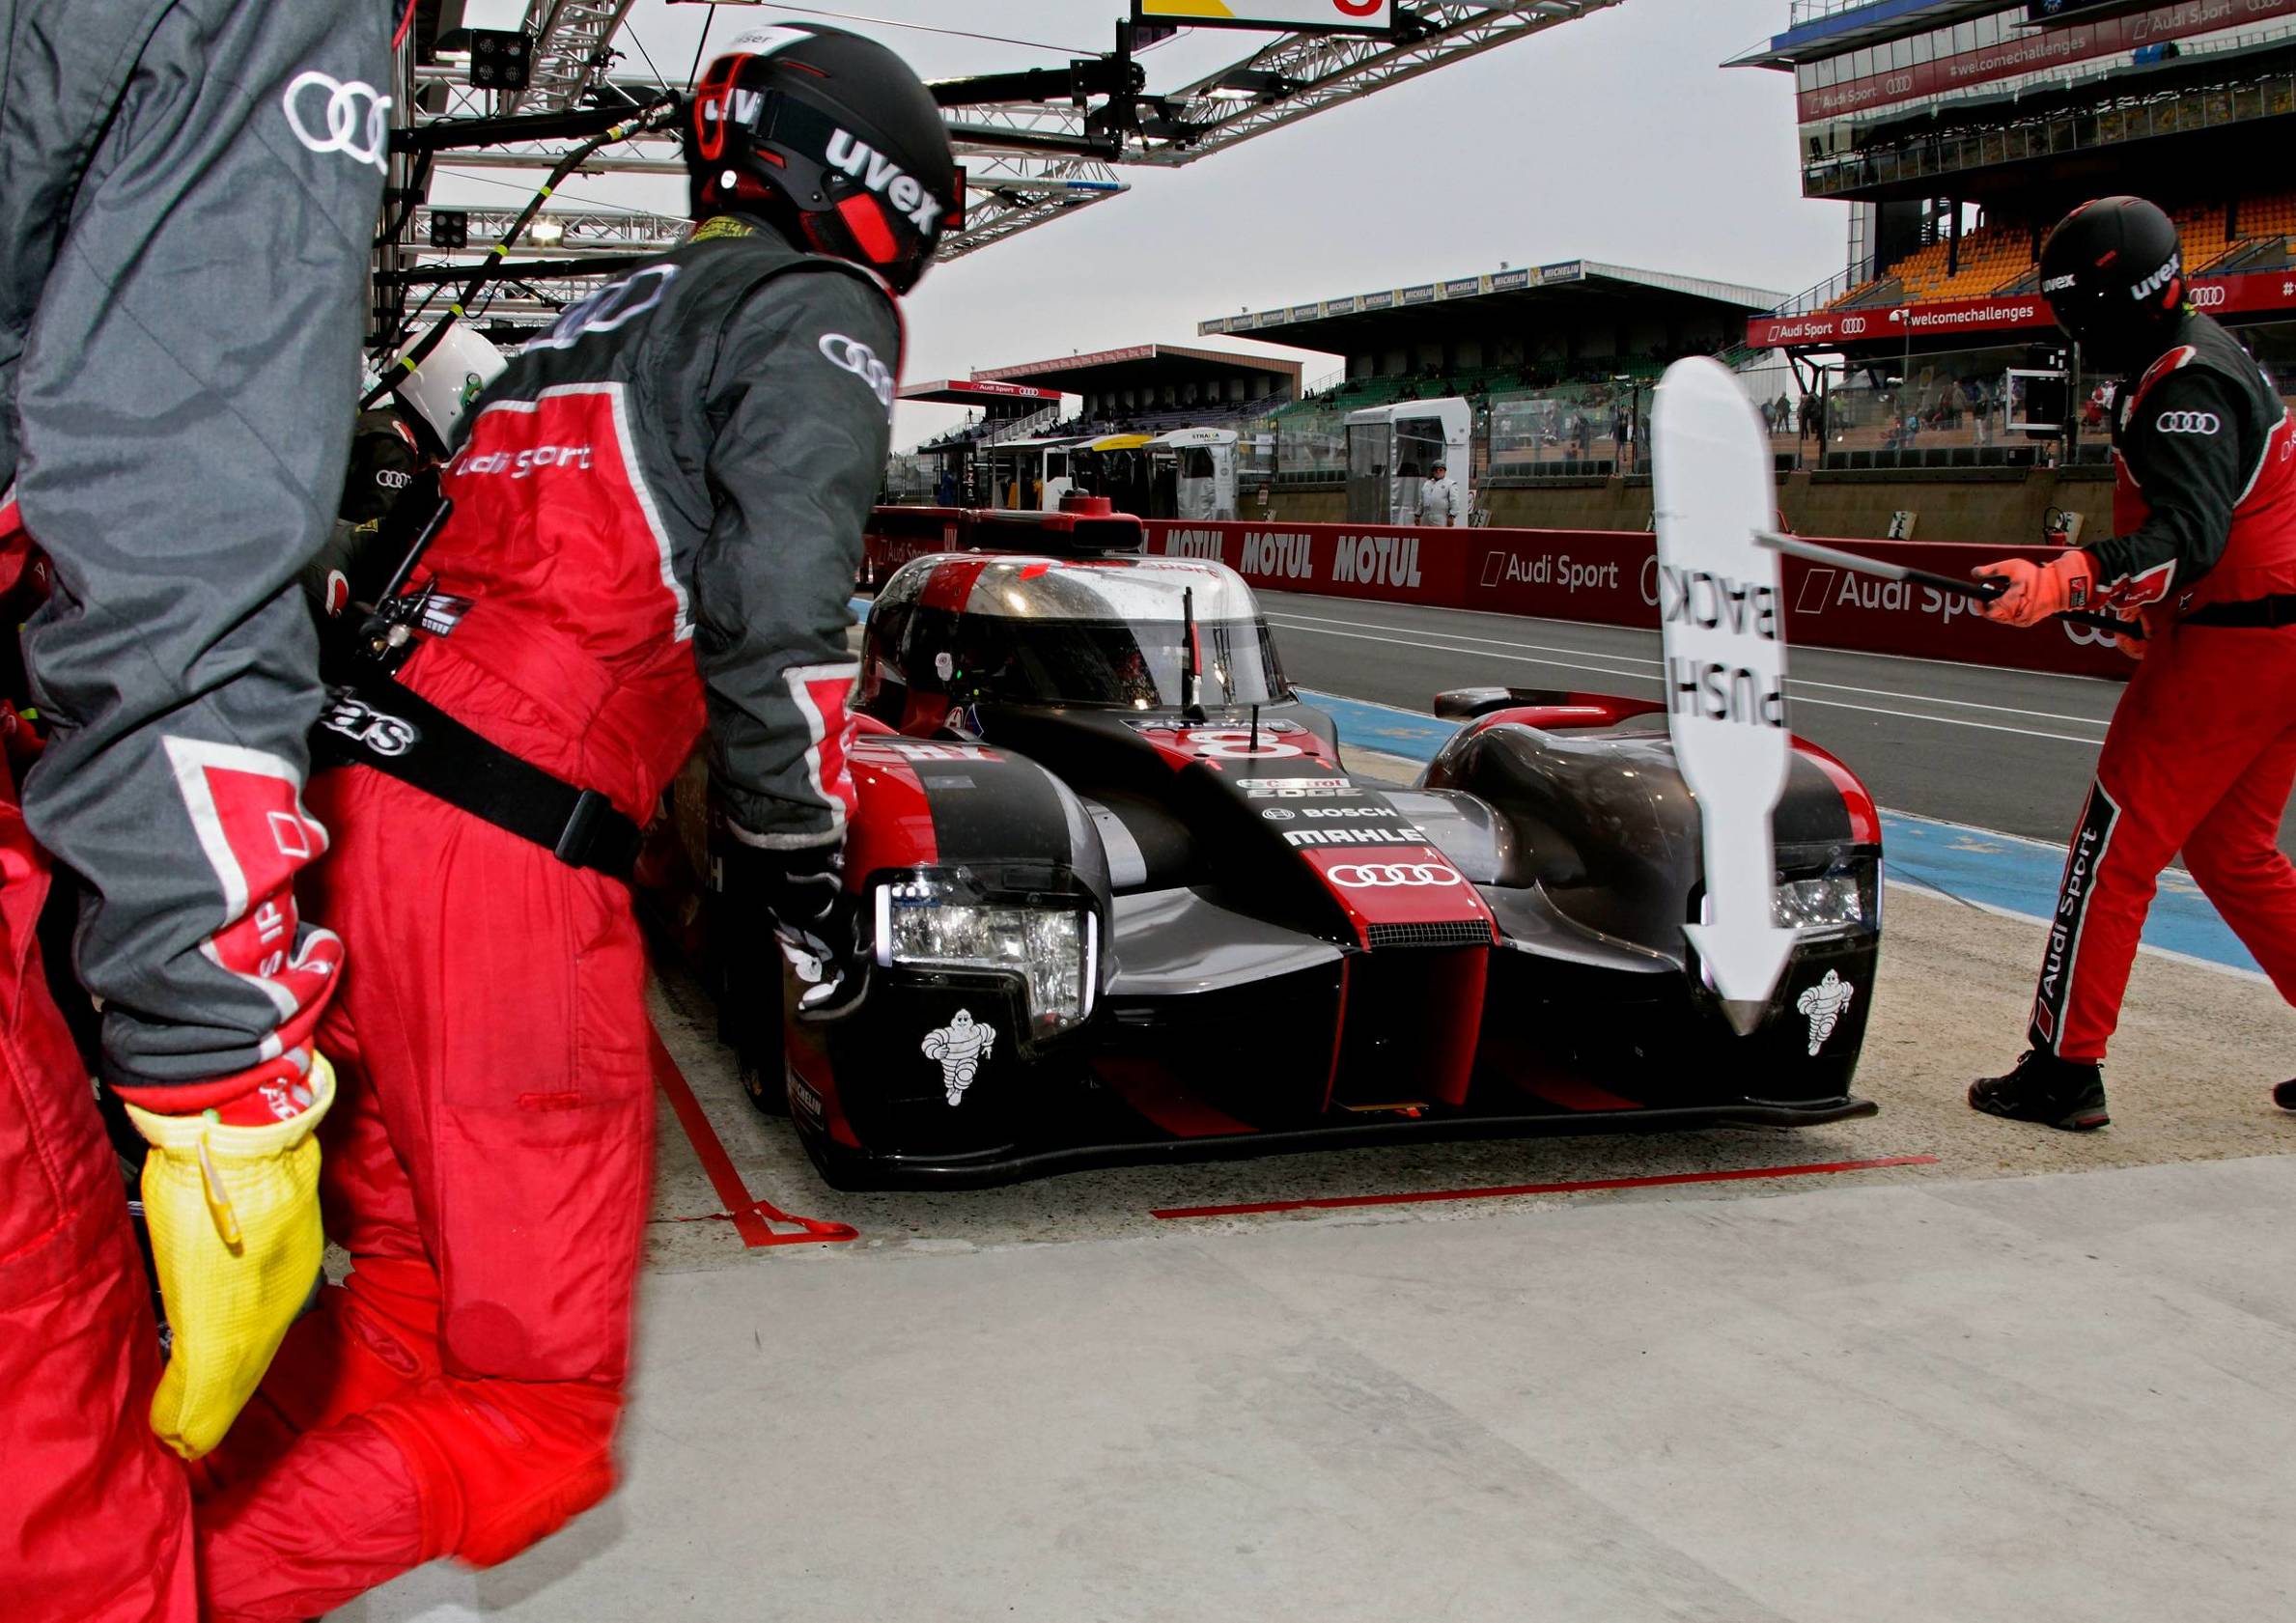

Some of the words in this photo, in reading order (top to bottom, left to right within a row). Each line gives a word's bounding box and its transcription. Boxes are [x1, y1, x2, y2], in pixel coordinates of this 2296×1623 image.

[2152, 11, 2188, 32] Audi
[2190, 3, 2232, 24] Sport
[1949, 37, 2086, 76] #welcomechallenges
[1823, 93, 1847, 109] Audi
[1847, 86, 1878, 104] Sport
[826, 127, 943, 235] uvex
[1494, 271, 1526, 285] MICHELIN
[1544, 264, 1581, 278] MICHELIN
[2041, 273, 2076, 294] uvex
[2131, 253, 2180, 300] uvex
[1779, 323, 1803, 338] Audi
[1805, 322, 1833, 338] Sport
[1905, 306, 2033, 326] welcomechallenges
[1165, 529, 1224, 564] MOTUL
[1241, 532, 1312, 578] MOTUL
[1332, 535, 1421, 588] MOTUL
[1506, 553, 1552, 583] Audi
[1557, 555, 1618, 593] Sport
[1662, 565, 1784, 641] BACK
[1836, 571, 1911, 611] Audi
[1669, 657, 1790, 729] PUSH
[1187, 731, 1303, 759] 8
[1302, 807, 1398, 818] BOSCH
[1282, 827, 1427, 847] MAHLE
[2042, 923, 2068, 997] Audi
[2058, 827, 2097, 916] Sport
